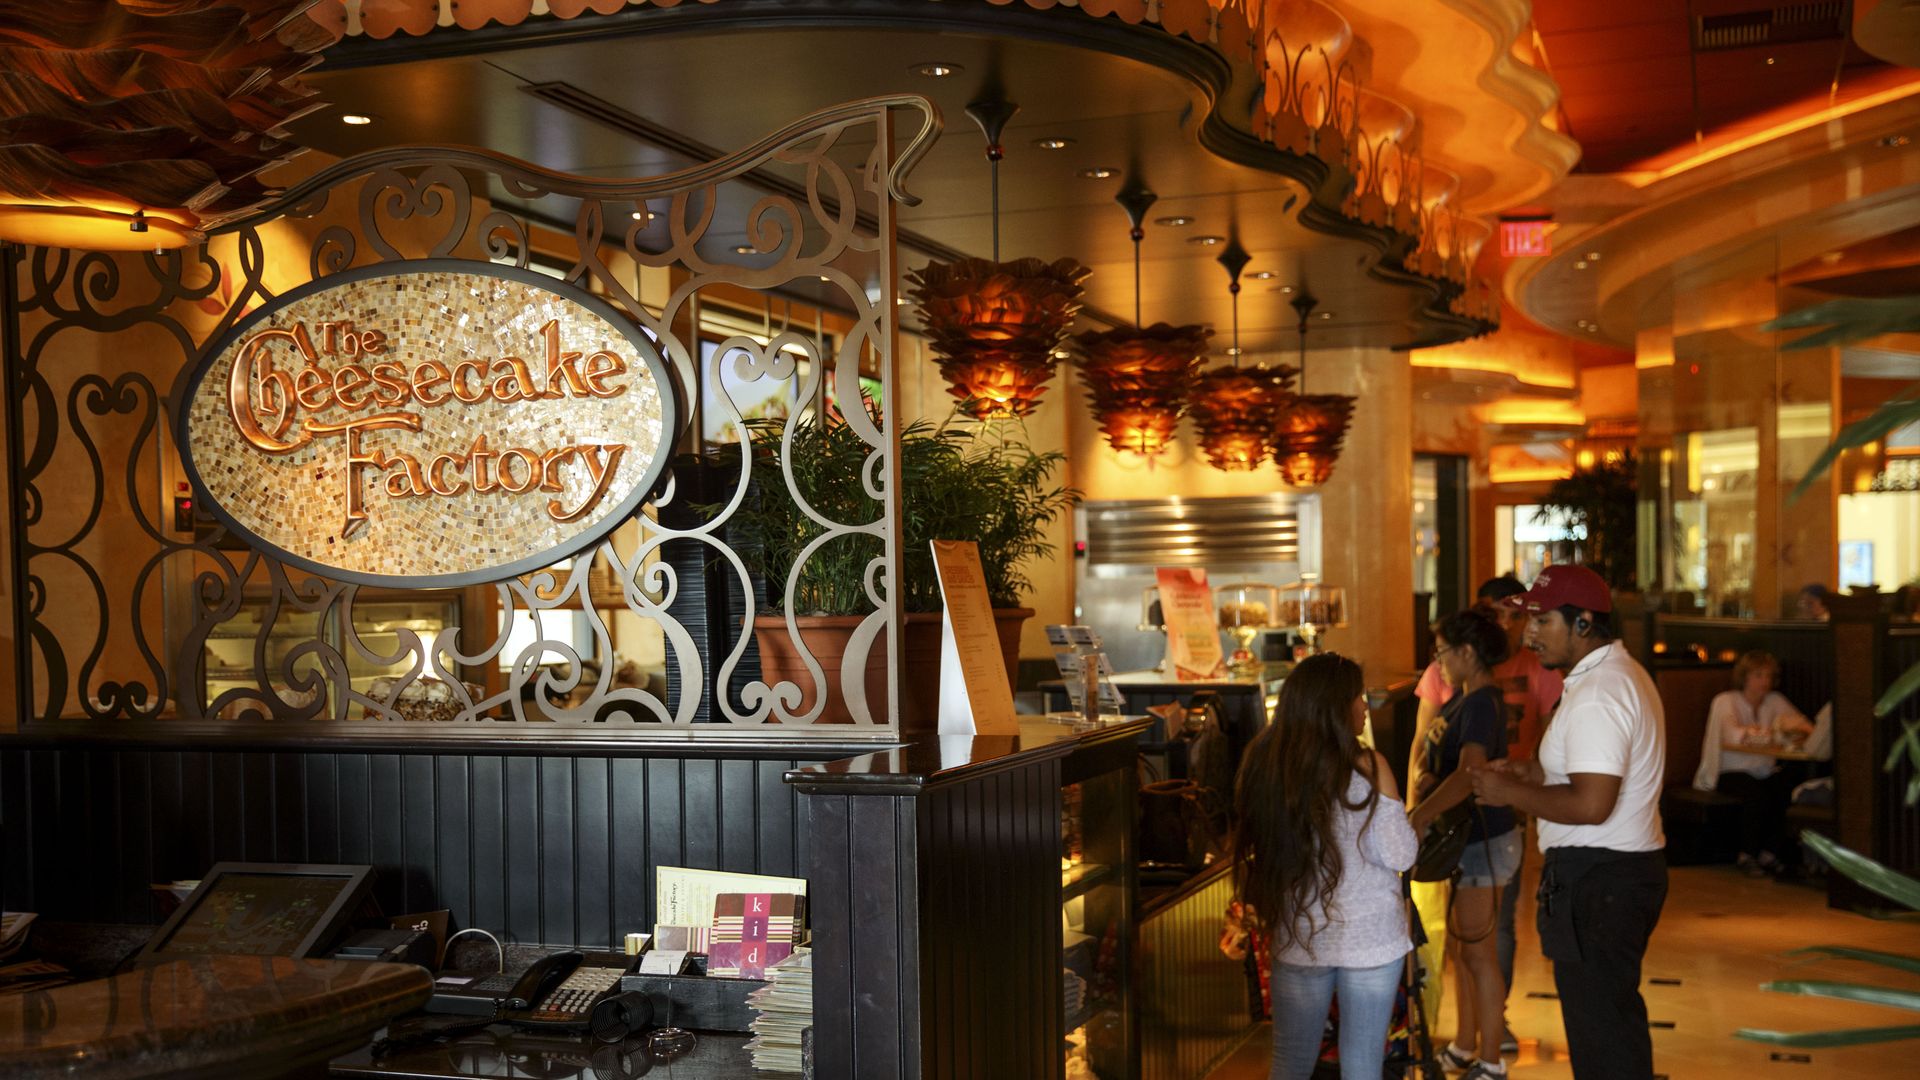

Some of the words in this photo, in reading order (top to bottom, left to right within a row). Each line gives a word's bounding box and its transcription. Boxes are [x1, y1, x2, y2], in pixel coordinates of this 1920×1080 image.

[229, 319, 627, 453] Cheesecake
[318, 321, 384, 361] The
[303, 411, 626, 539] Factory
[747, 897, 763, 979] kid
